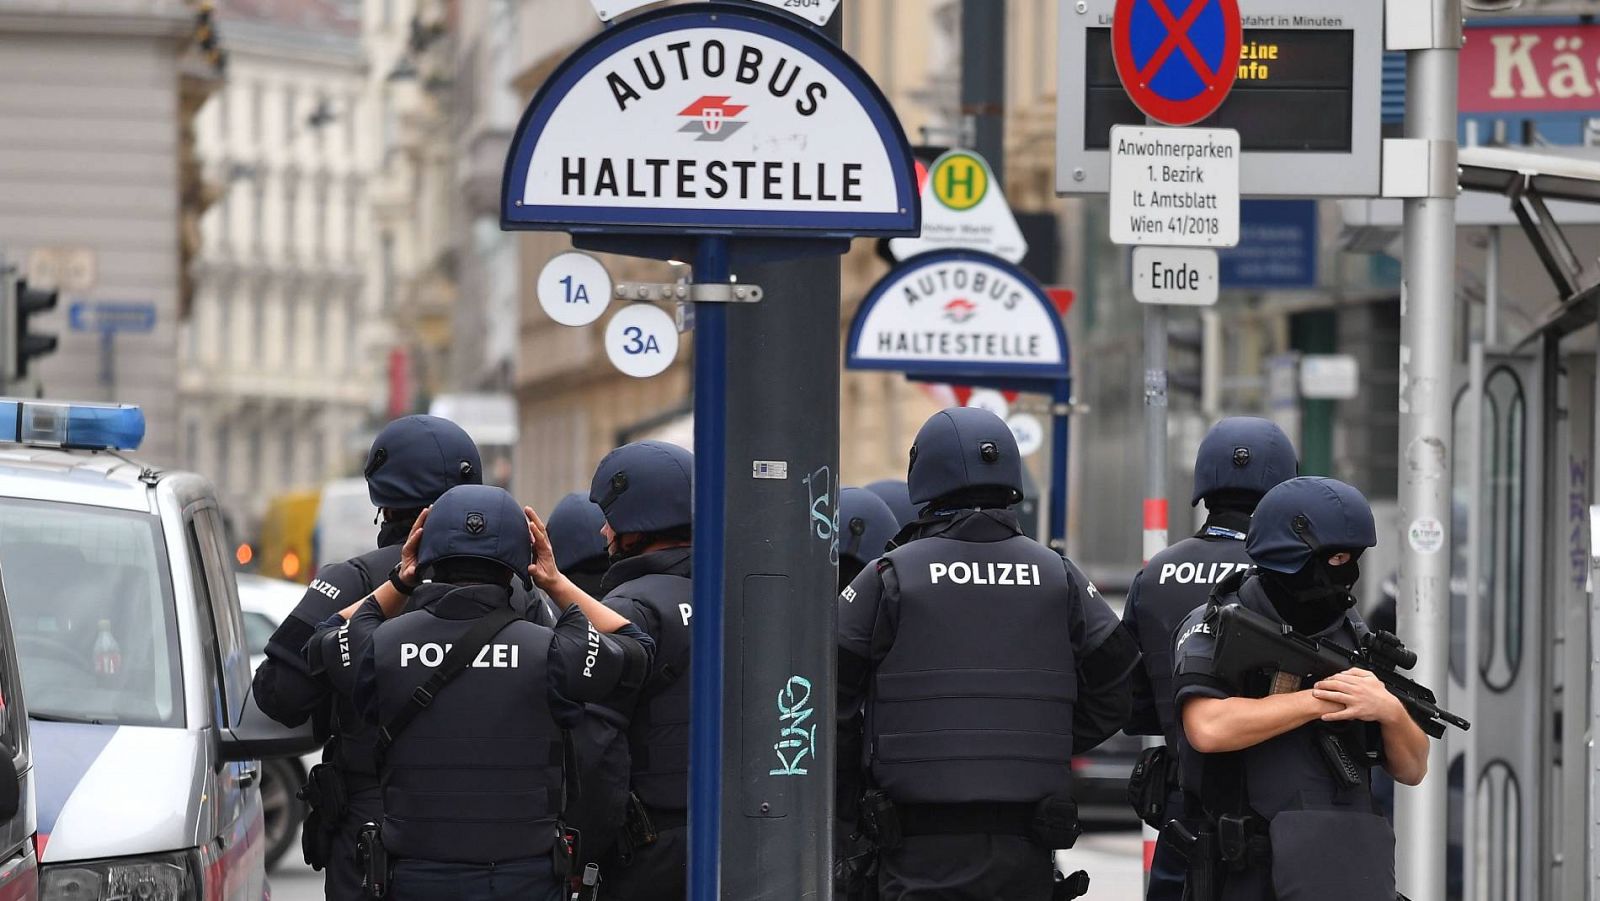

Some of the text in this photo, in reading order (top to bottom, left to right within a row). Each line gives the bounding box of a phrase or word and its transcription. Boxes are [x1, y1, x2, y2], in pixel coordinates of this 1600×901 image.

[1278, 16, 1289, 26] in
[1293, 16, 1342, 26] Minuten
[1239, 41, 1278, 59] eine
[606, 39, 827, 116] AUTOBUS
[1238, 61, 1269, 80] nfo
[1489, 34, 1600, 98] Kä
[1118, 139, 1233, 160] Anwohnerparken
[562, 156, 862, 201] HALTESTELLE
[946, 165, 974, 200] H
[1147, 165, 1204, 183] 1. Bezirk
[1133, 191, 1217, 209] lt. Amtsblatt
[1130, 216, 1219, 236] Wien 41/2018
[1151, 262, 1199, 290] Ende
[559, 276, 589, 304] 1A
[903, 269, 1023, 311] AUTOBUS
[623, 327, 660, 355] 3A
[877, 332, 1041, 357] HALTESTELLE
[929, 561, 1041, 586] POLIZEI
[400, 642, 519, 668] POZEI
